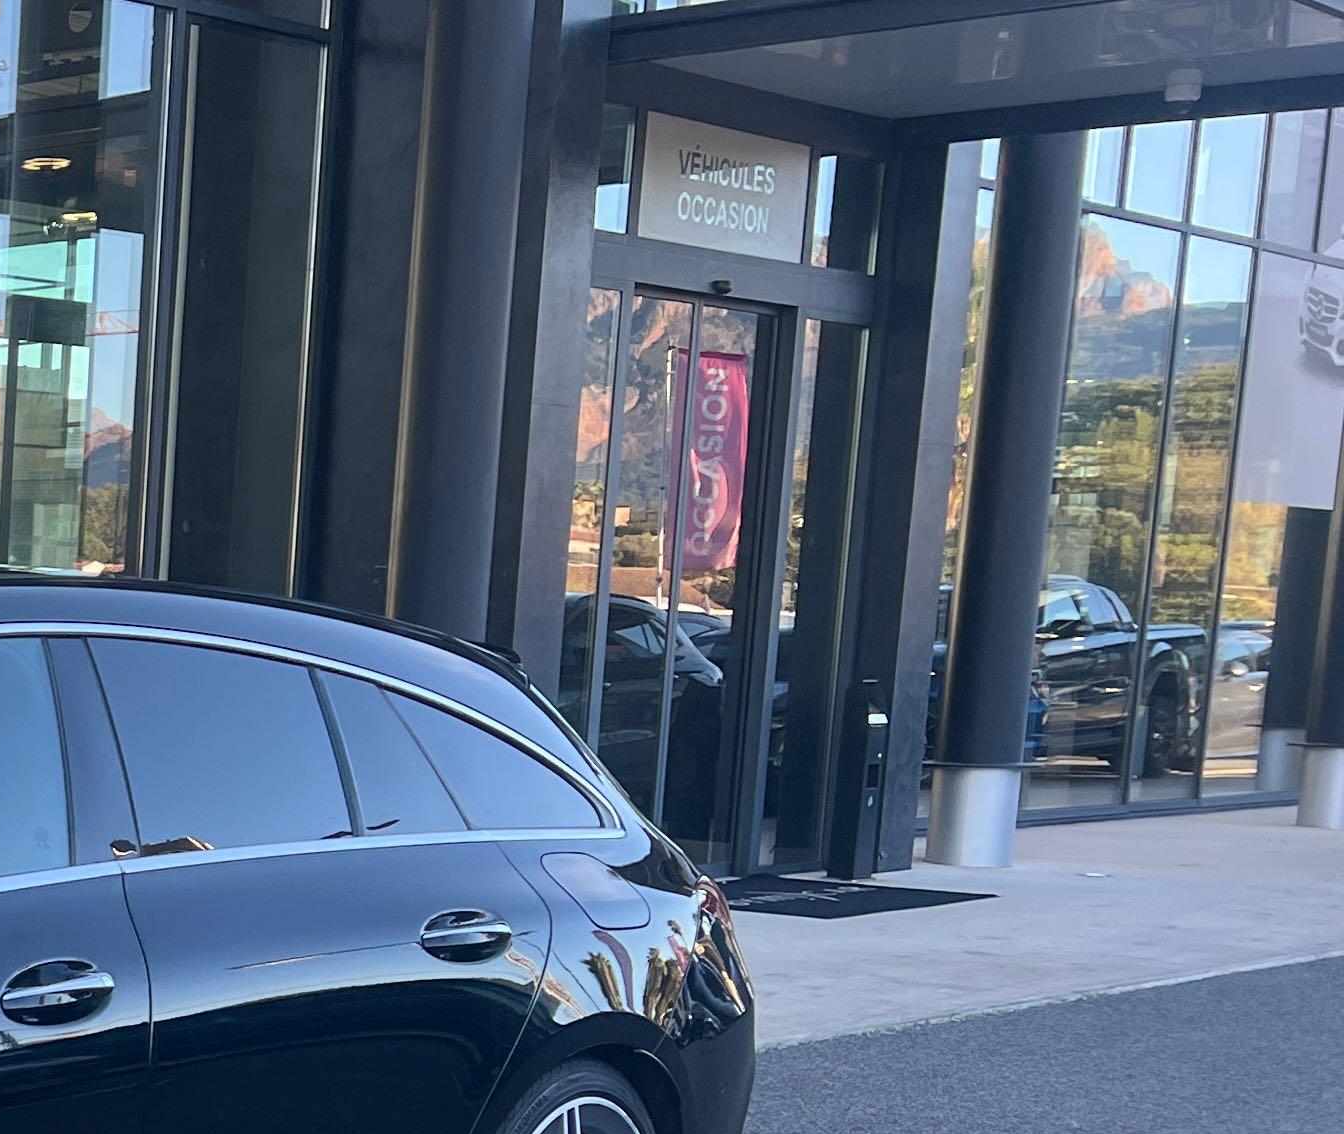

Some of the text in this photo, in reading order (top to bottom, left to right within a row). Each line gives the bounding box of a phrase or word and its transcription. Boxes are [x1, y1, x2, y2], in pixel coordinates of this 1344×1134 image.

[678, 144, 776, 195] VÉHICULES
[677, 191, 770, 234] OCCASION
[690, 366, 730, 557] OCCASION
